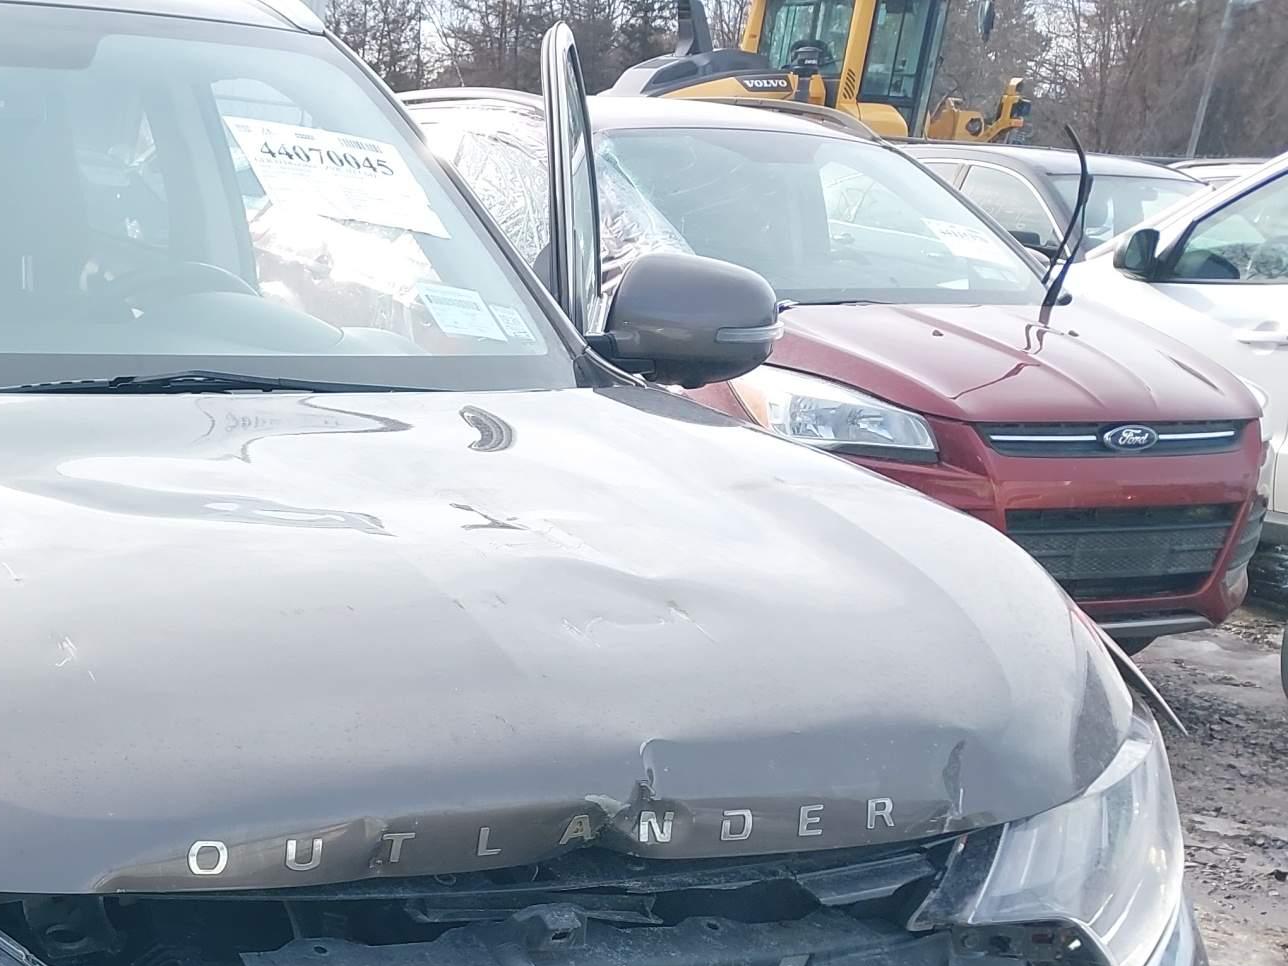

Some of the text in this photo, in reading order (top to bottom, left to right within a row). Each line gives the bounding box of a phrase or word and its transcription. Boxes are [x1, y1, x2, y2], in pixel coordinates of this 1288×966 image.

[743, 79, 788, 88] VOLVO
[259, 141, 395, 177] 44070045
[1118, 428, 1149, 446] Ford
[186, 796, 896, 877] OUTLANDER
